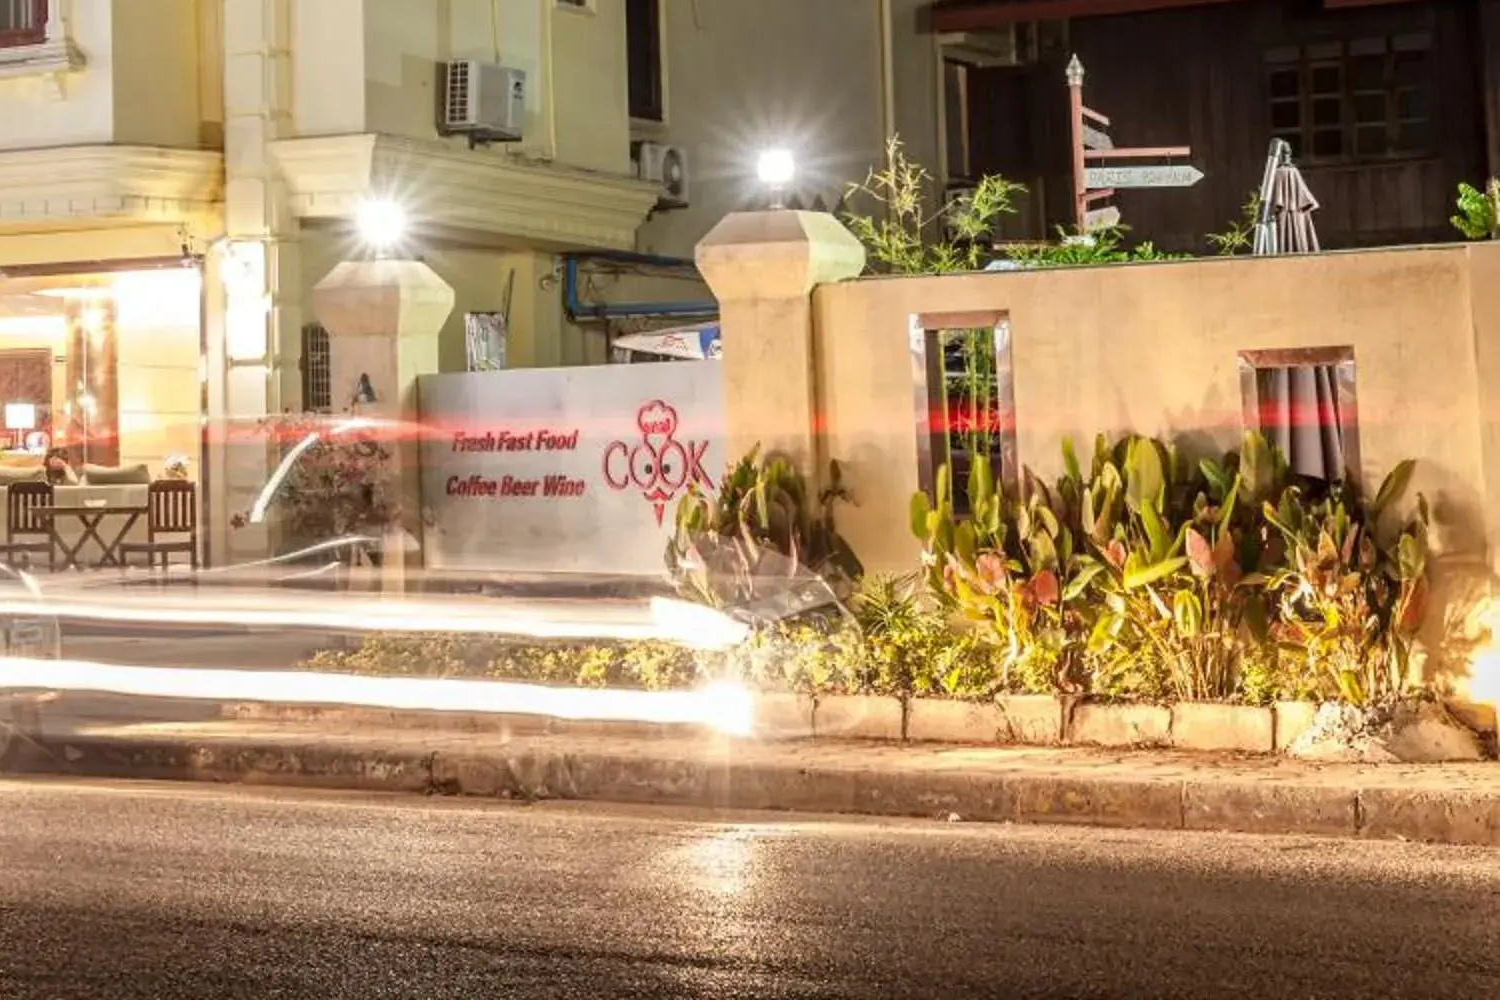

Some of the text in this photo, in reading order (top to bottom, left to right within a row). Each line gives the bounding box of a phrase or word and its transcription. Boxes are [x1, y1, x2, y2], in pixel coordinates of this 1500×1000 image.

[451, 429, 580, 452] Fresh Fast Food
[603, 439, 715, 491] COOK
[445, 474, 586, 496] Coffee Beer Wine
